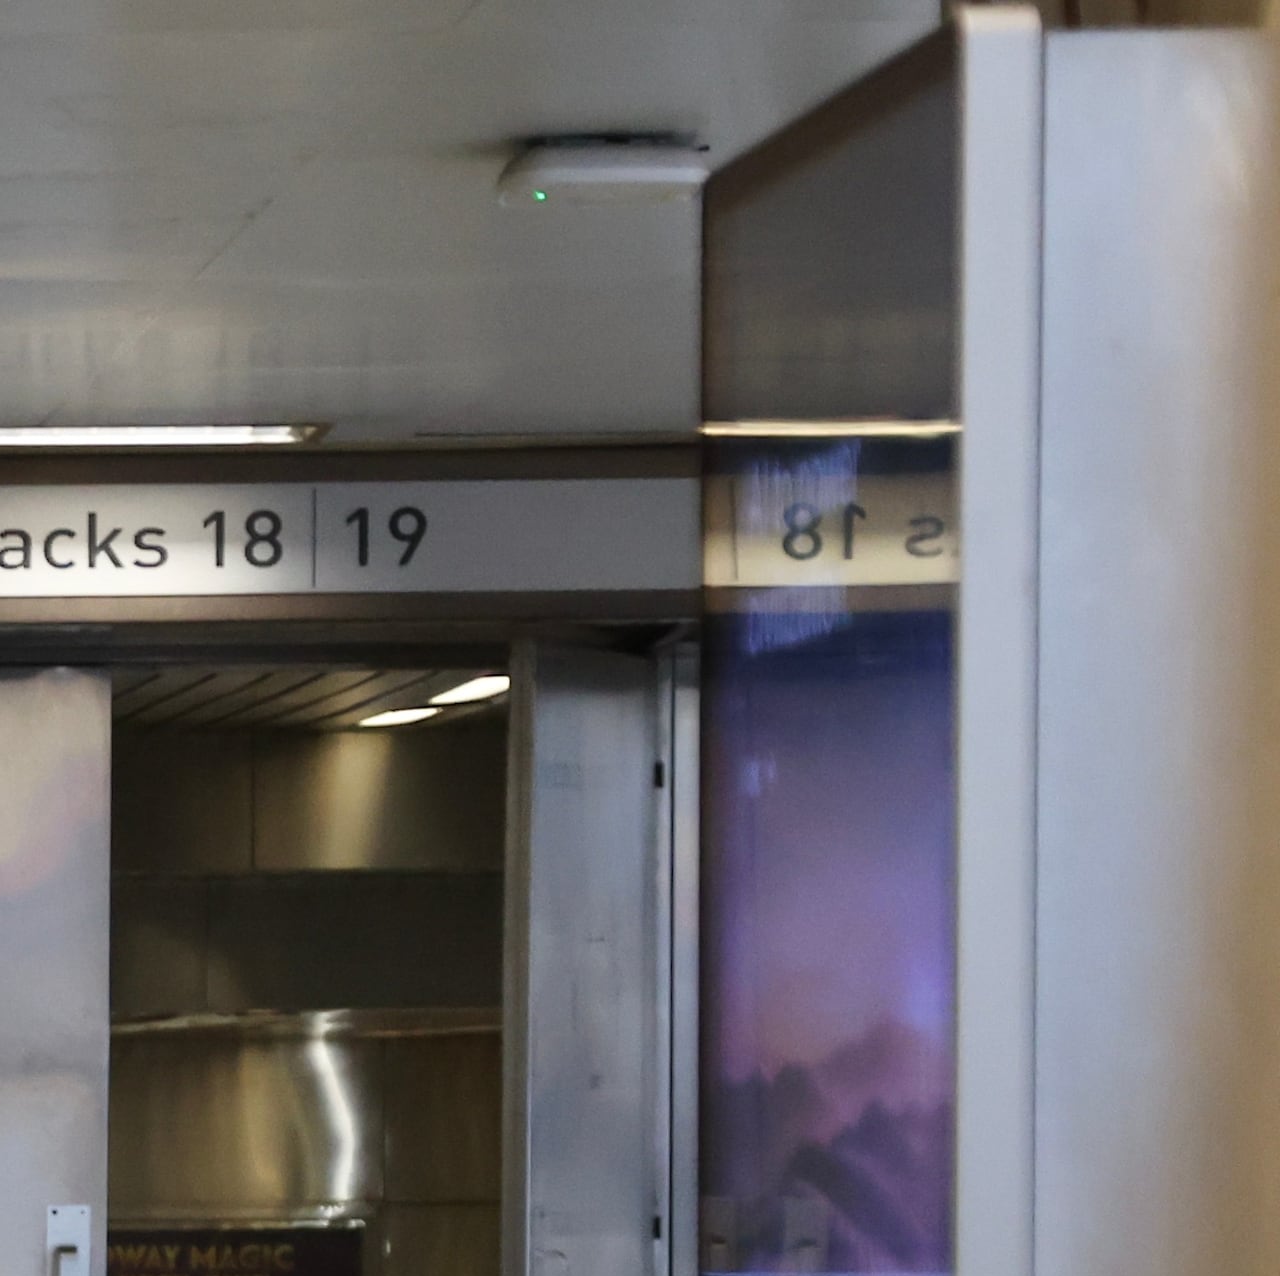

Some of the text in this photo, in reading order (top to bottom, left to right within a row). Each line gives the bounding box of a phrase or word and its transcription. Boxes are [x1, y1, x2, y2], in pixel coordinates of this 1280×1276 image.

[202, 509, 284, 568] 18
[346, 506, 428, 566] 19
[110, 1243, 295, 1271] WAY MAGIC
